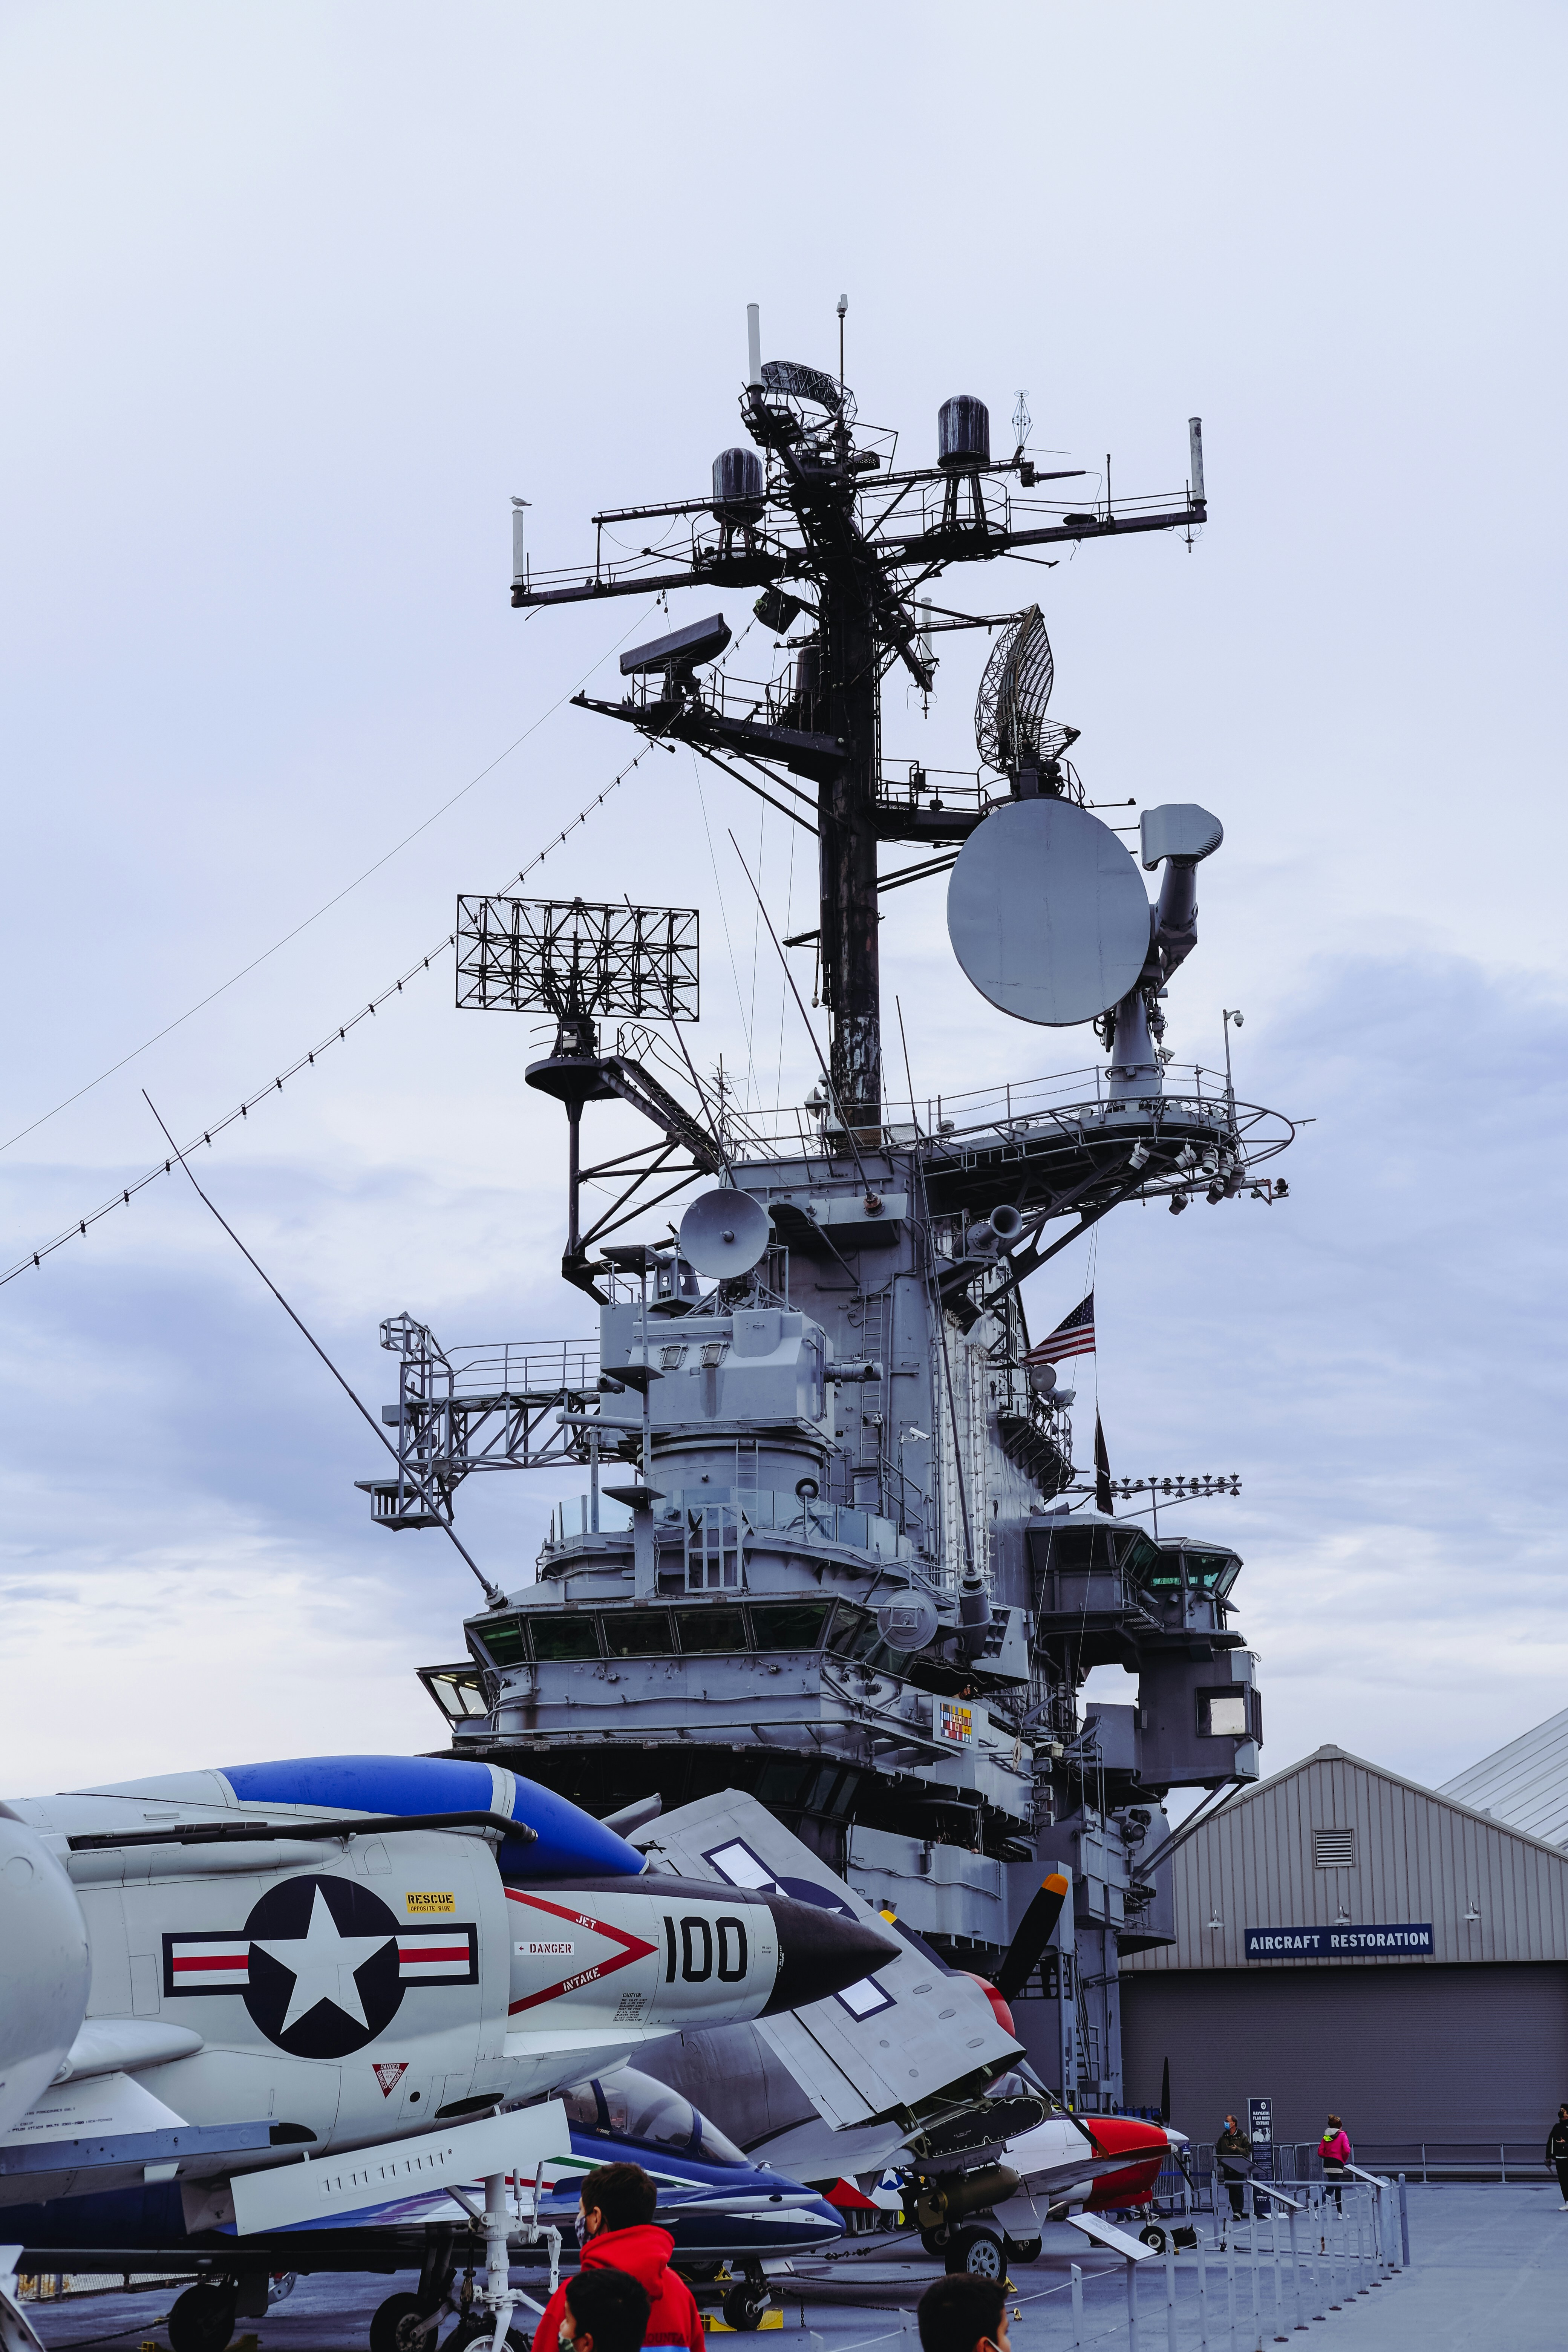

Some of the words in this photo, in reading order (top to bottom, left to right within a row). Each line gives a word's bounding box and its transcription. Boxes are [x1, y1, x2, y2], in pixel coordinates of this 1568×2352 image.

[407, 1894, 453, 1904] RESCUE
[575, 1915, 597, 1929] JET
[530, 1943, 572, 1953] DANGER
[663, 1916, 748, 1983] 100
[1250, 1935, 1320, 1950] AIRCRAFT
[1331, 1932, 1429, 1948] RESTORATION
[563, 1967, 600, 1992] INTAKE
[377, 2070, 387, 2090] DANGER
[388, 2069, 403, 2089] DANGER
[646, 2332, 689, 2344] OUNTA
